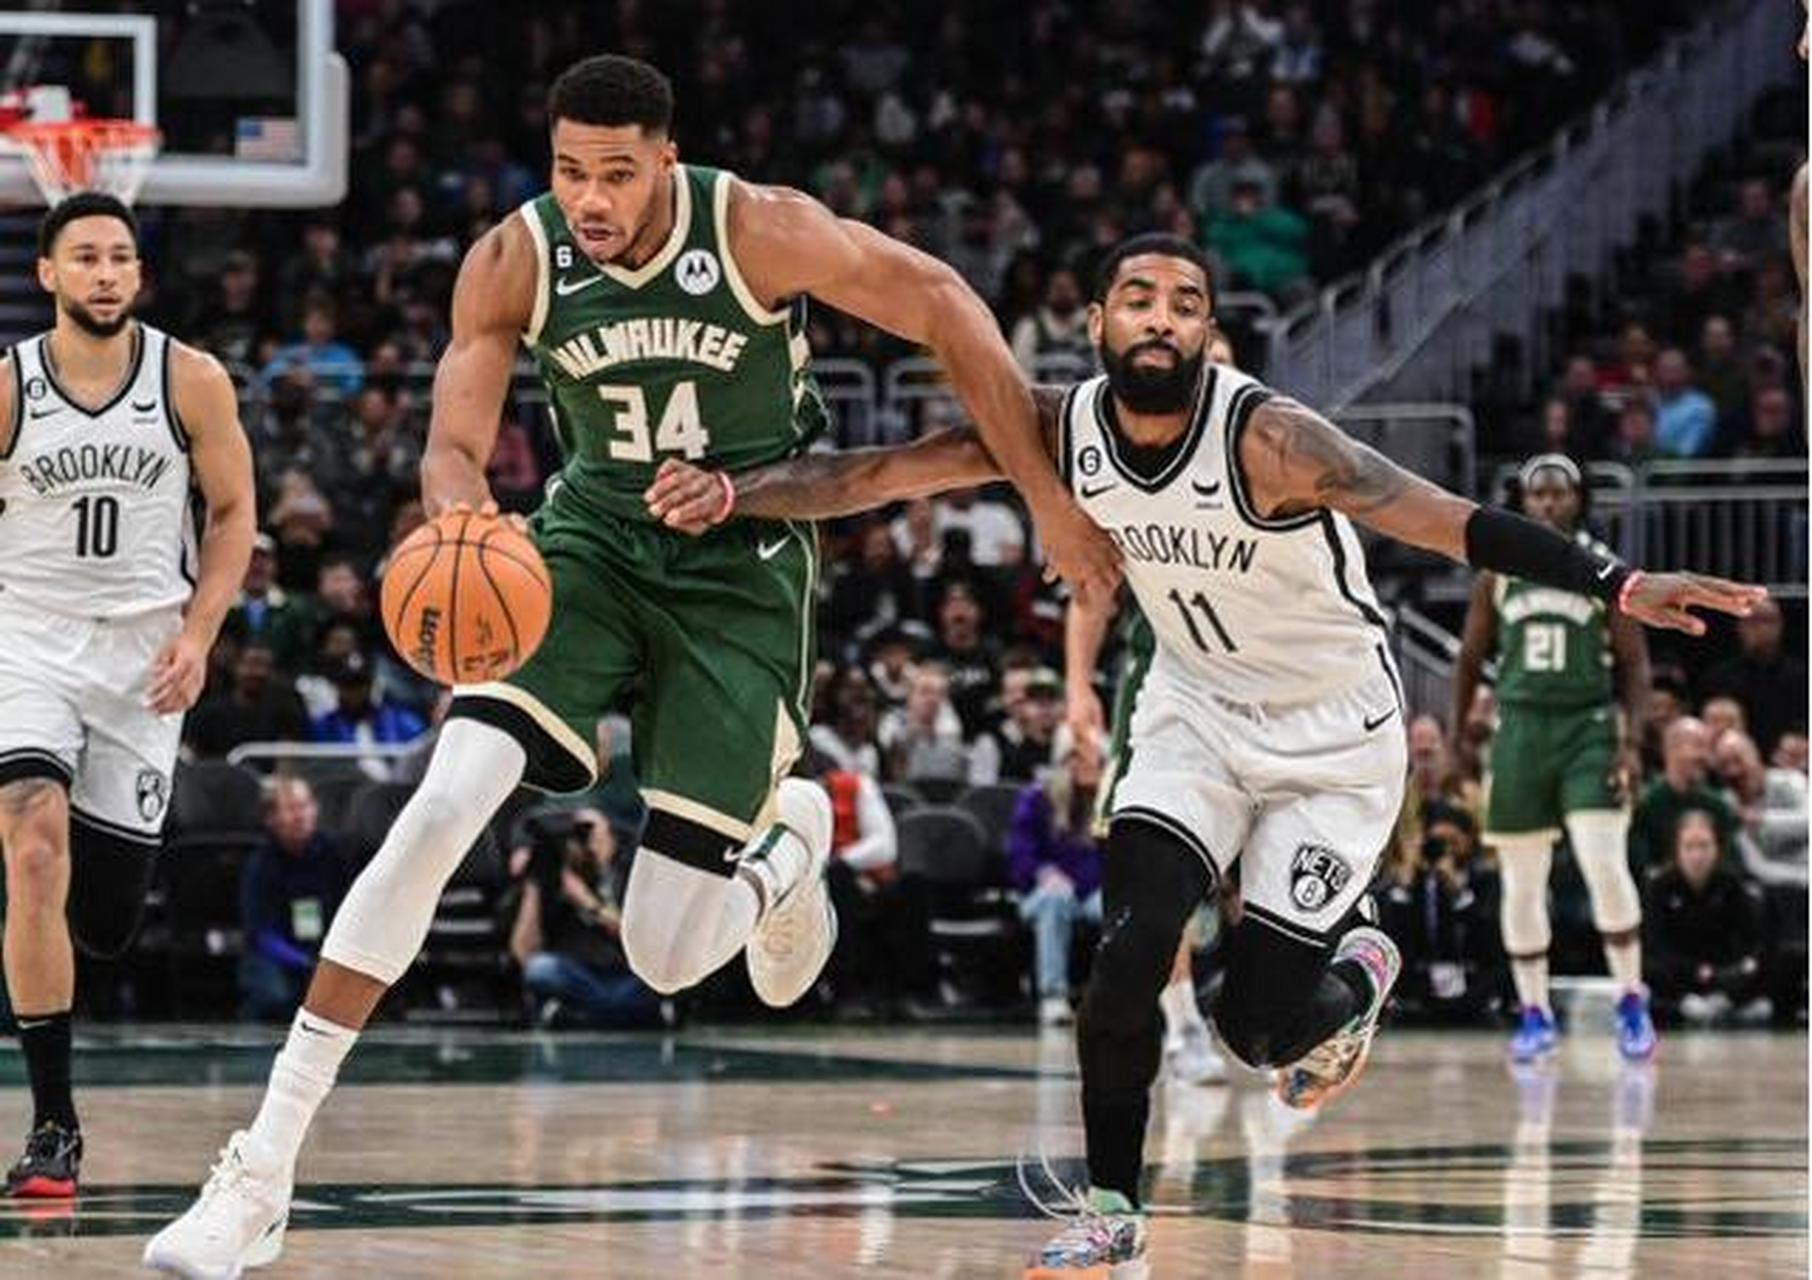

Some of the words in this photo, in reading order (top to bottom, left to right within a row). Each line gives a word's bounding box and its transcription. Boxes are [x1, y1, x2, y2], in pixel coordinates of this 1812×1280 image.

[556, 246, 572, 268] 6
[597, 381, 710, 462] 34
[20, 444, 170, 493] BROOKLYN
[72, 496, 119, 557] 10
[1168, 589, 1238, 653] 11
[1525, 624, 1566, 672] 21
[1292, 847, 1348, 891] NETS
